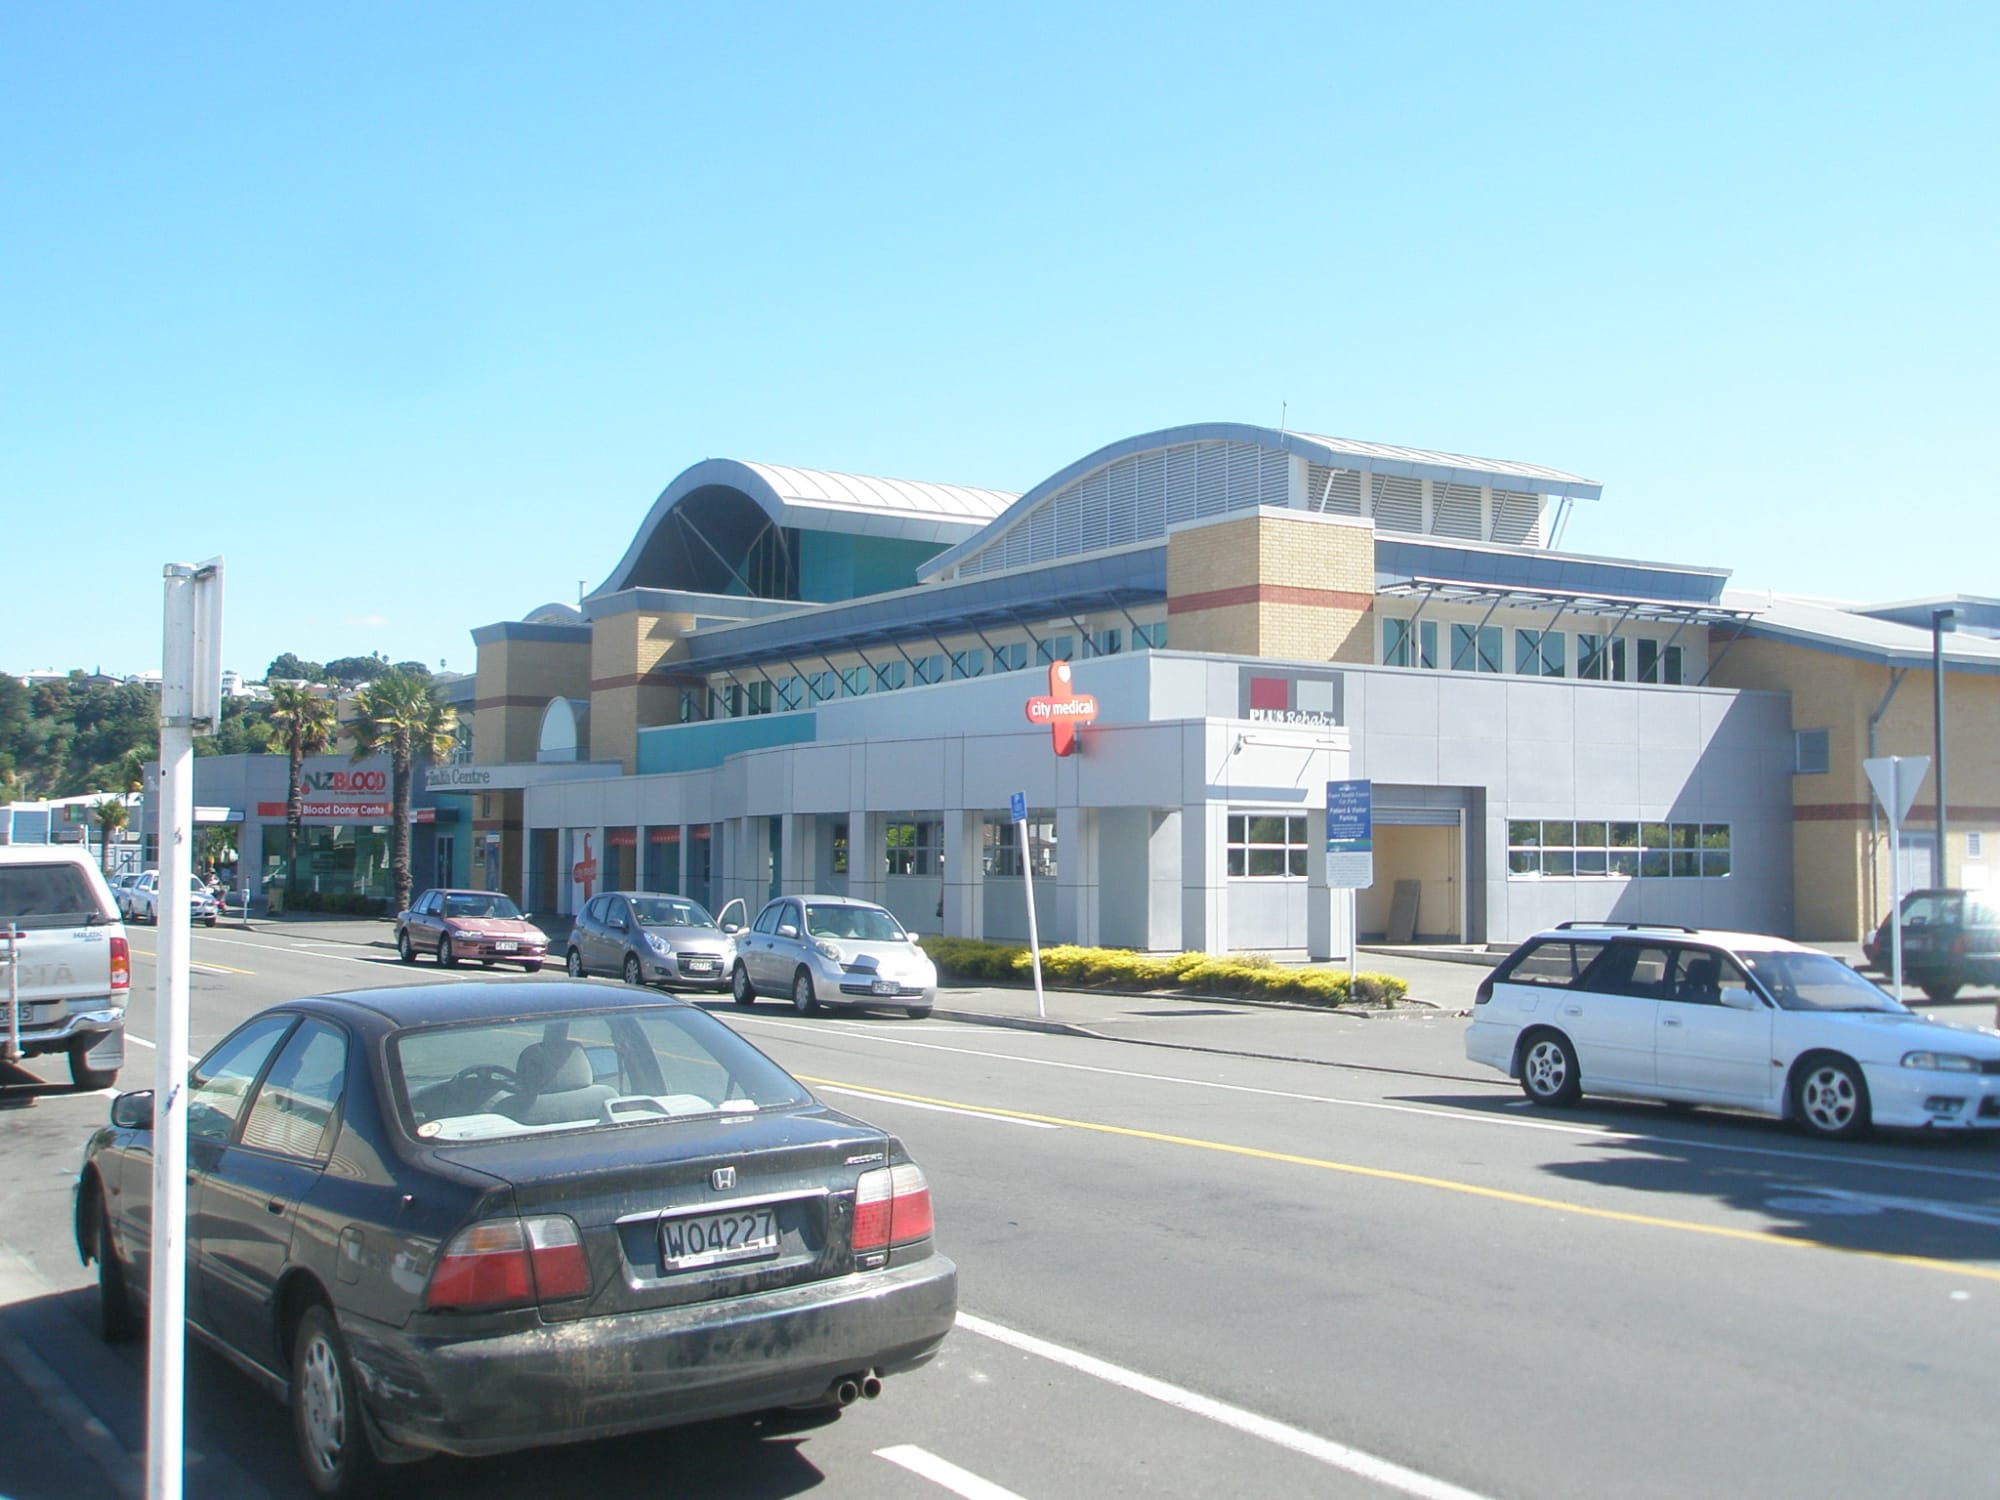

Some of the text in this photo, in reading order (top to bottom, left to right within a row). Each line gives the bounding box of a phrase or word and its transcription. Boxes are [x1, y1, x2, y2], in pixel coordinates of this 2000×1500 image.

[1031, 699, 1094, 719] city medical
[1249, 708, 1285, 724] PLUS
[452, 768, 490, 785] Centre
[303, 804, 331, 815] Blood
[333, 804, 359, 815] Donor
